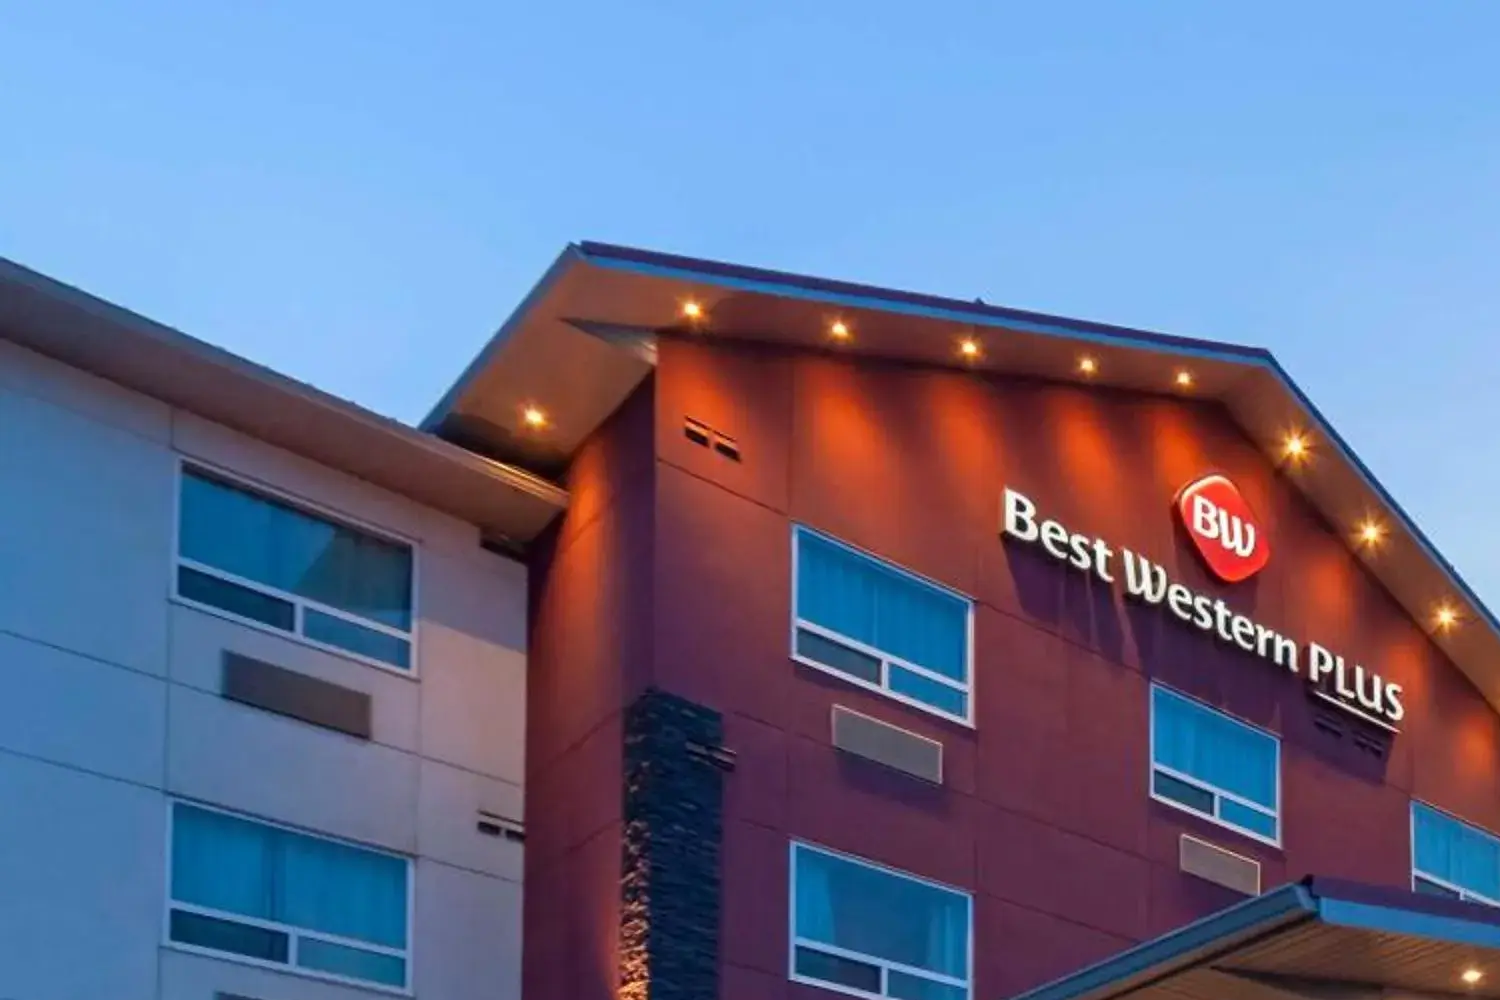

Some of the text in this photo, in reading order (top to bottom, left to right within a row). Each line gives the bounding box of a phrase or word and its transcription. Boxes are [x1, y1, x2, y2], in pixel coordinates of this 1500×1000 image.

[1193, 495, 1256, 557] BW
[1003, 487, 1405, 722] Best Western PLUS
